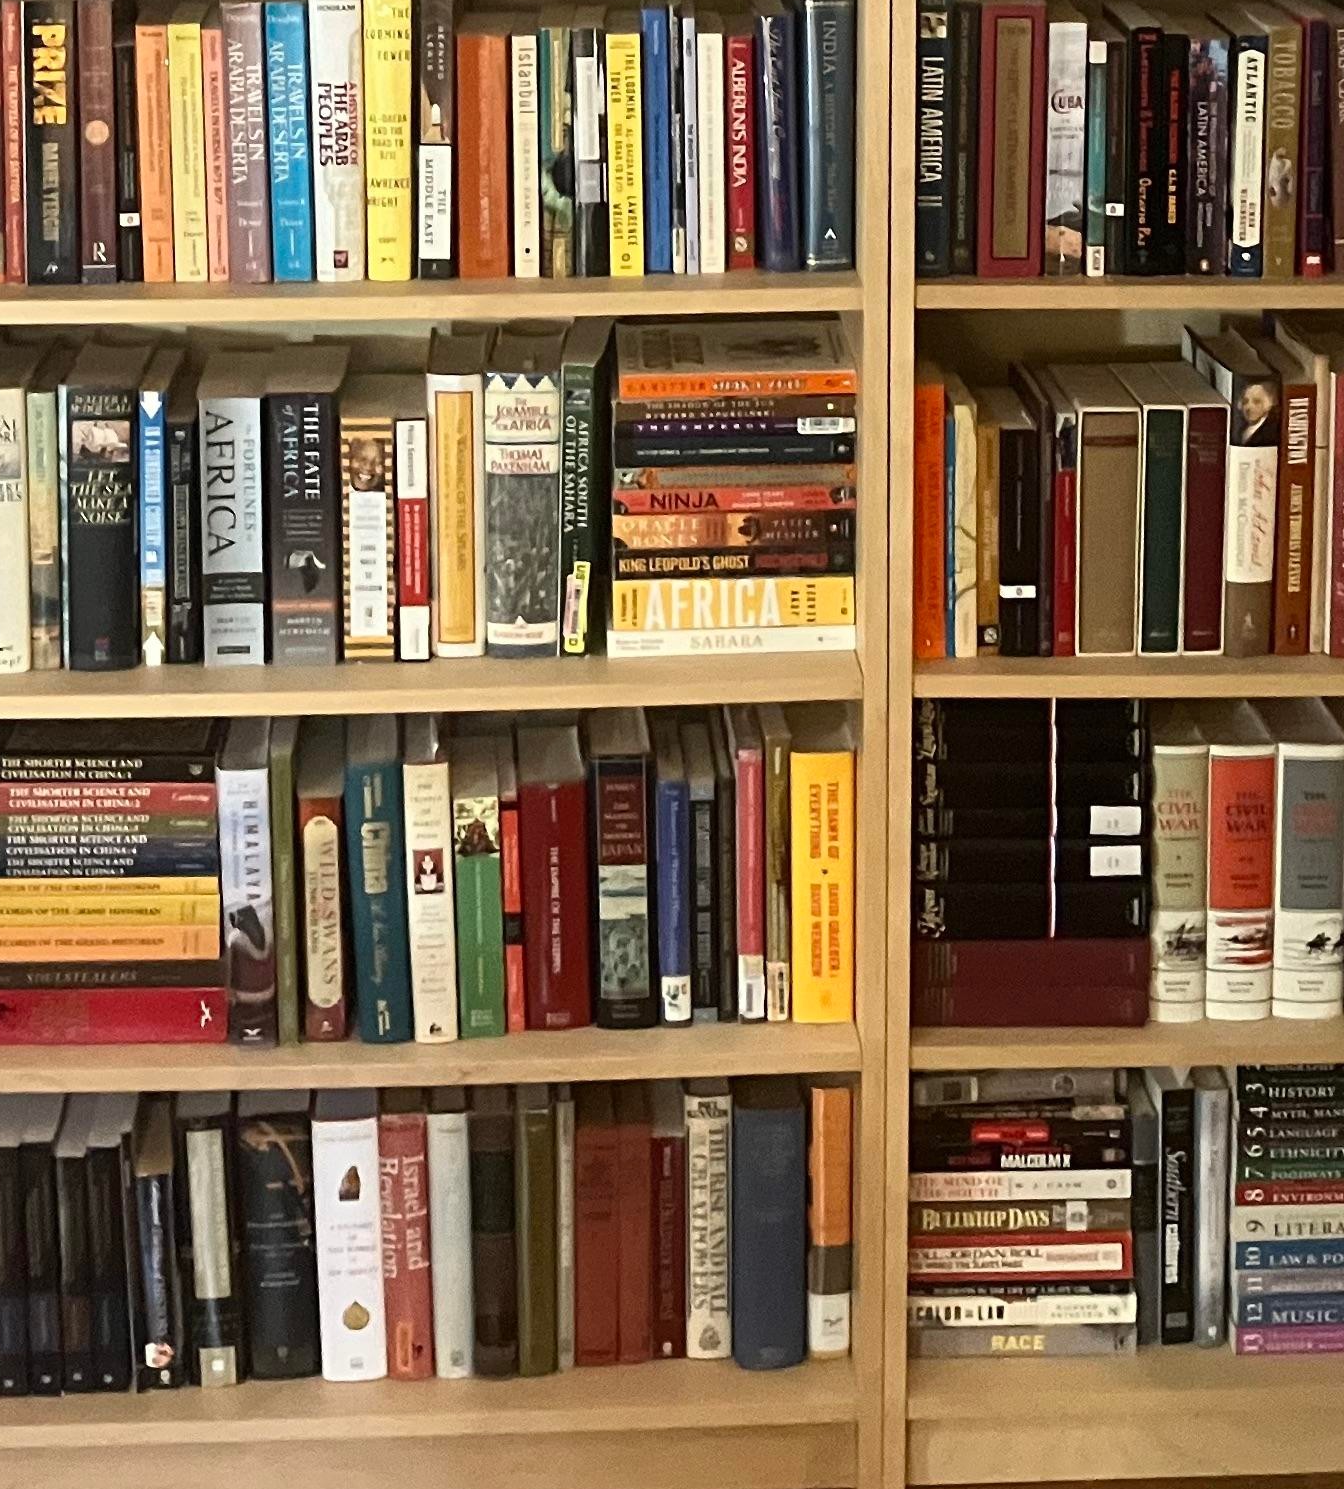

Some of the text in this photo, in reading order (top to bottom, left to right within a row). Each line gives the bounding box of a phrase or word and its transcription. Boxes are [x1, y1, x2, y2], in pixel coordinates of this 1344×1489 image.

[32, 24, 67, 127] PRIZE
[519, 47, 535, 114] Istanbul
[921, 56, 945, 103] LATIN
[1245, 56, 1257, 123] ATLANTIC
[1272, 39, 1297, 128] TOBACCO
[920, 106, 944, 183] AMERICA
[205, 411, 237, 557] AFRICA
[282, 427, 300, 499] AFRICA
[303, 402, 322, 501] THE FATE
[650, 493, 719, 509] NINJA
[619, 554, 750, 572] KING LEOPOLD'S GHOST
[644, 580, 780, 629] AFRICA
[242, 800, 258, 902] HIMALAYA
[1268, 1086, 1336, 1098] HISTORY
[402, 1154, 426, 1217] Israel
[1008, 1208, 1050, 1227] DAYS
[991, 1335, 1045, 1351] RACE
[1271, 1309, 1338, 1323] MUSIC
